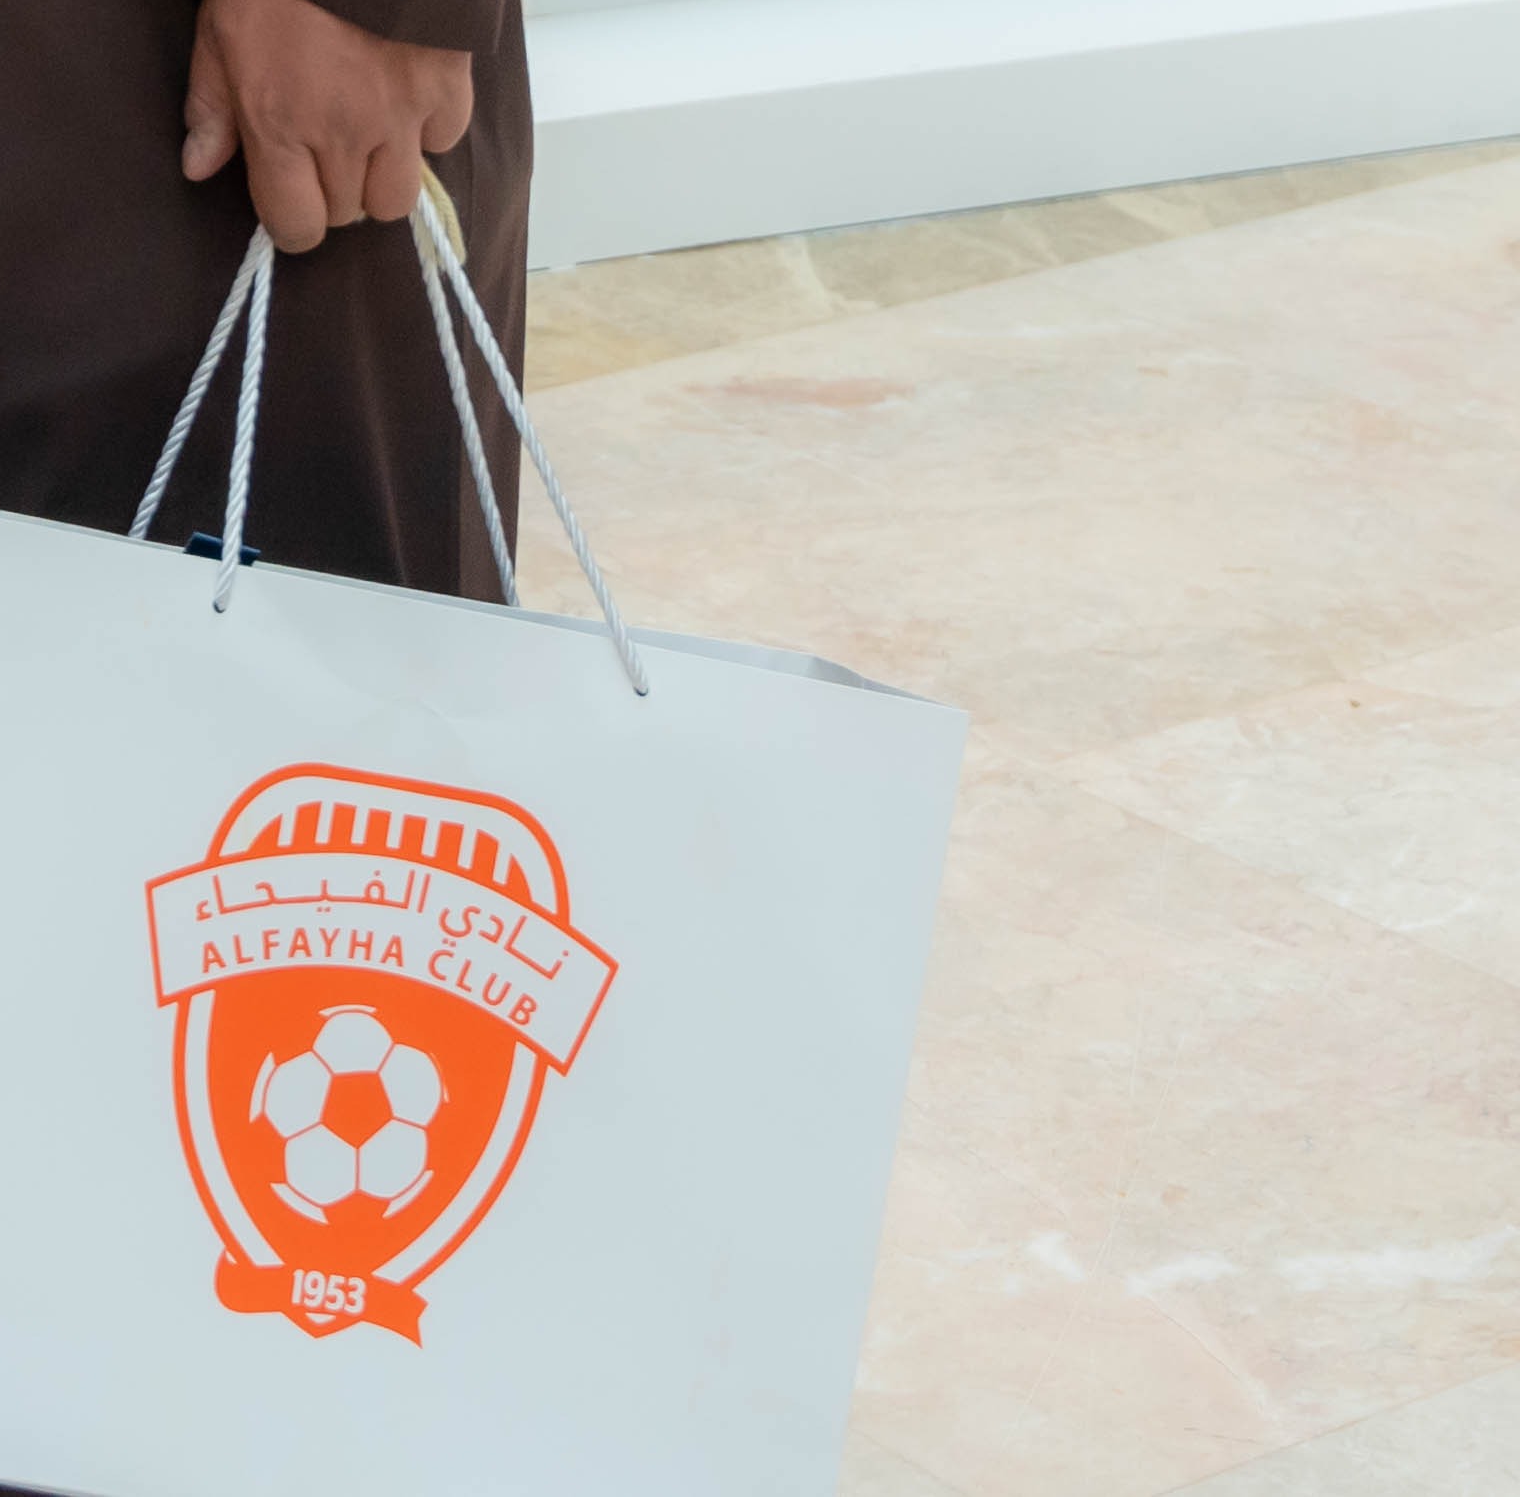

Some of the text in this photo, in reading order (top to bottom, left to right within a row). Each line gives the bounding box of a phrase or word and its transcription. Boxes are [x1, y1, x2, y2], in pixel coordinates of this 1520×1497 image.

[195, 869, 570, 981] نادي الفيحاء
[200, 927, 539, 1027] ALFAYHA CLUB
[291, 1268, 367, 1315] 1953
